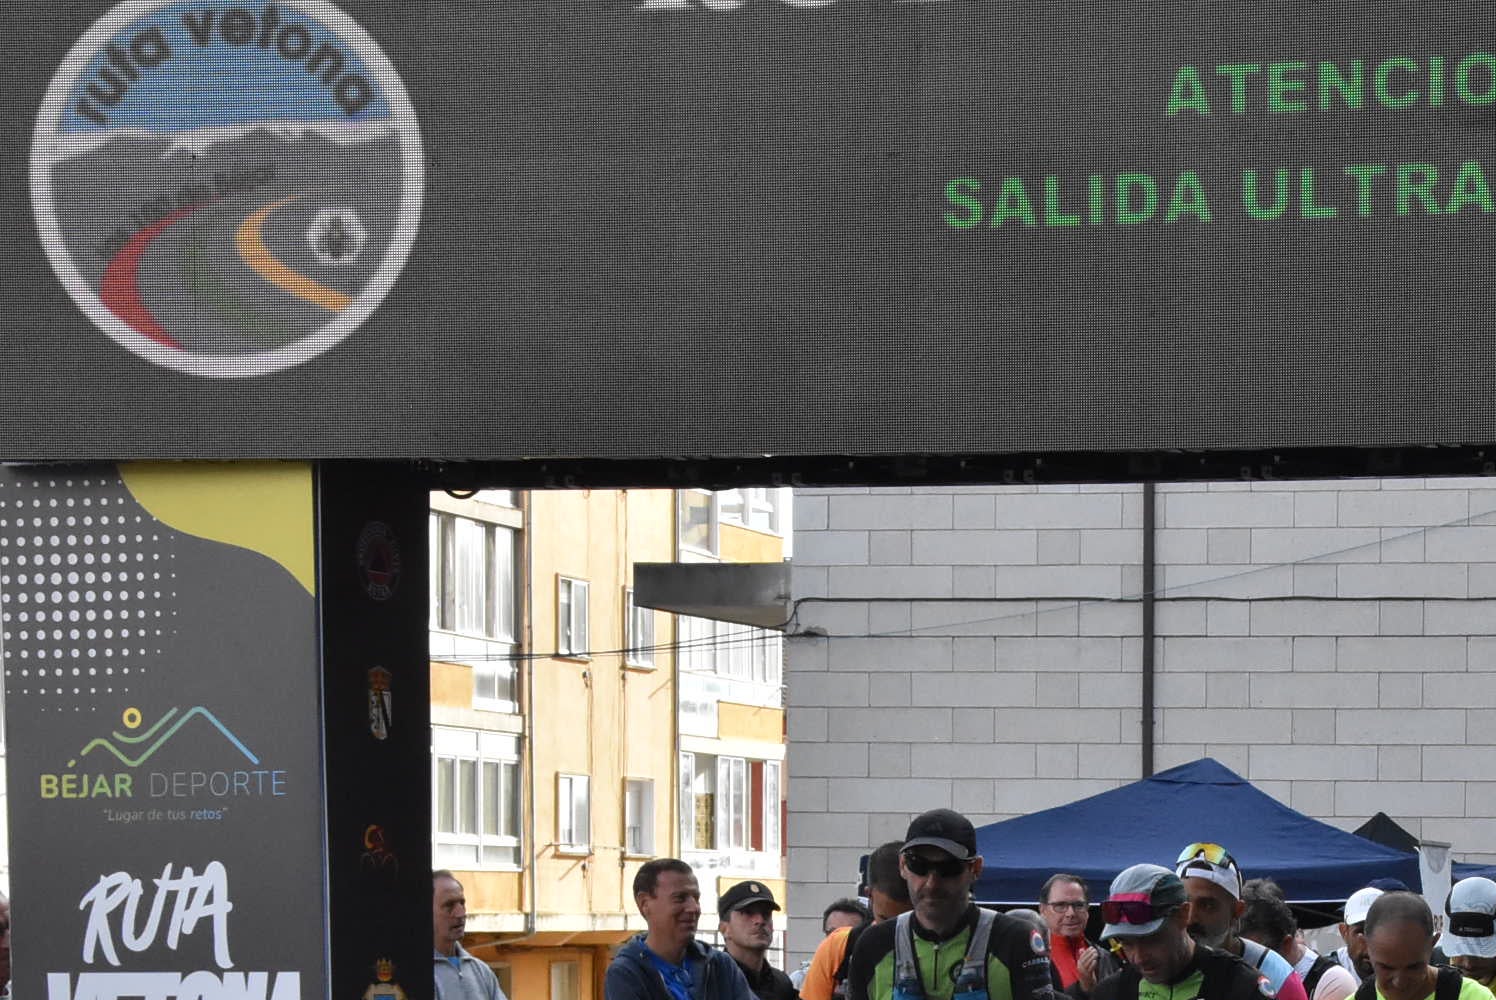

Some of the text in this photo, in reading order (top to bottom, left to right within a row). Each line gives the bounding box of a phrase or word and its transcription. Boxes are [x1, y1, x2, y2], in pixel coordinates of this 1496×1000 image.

[75, 3, 375, 126] ruta vetona
[944, 172, 1211, 229] SALIDA
[1241, 159, 1495, 220] ULTRA
[41, 760, 287, 798] BÉJAR DEPORTE
[148, 809, 161, 820] de
[167, 809, 185, 820] tus
[79, 861, 234, 968] RUTA
